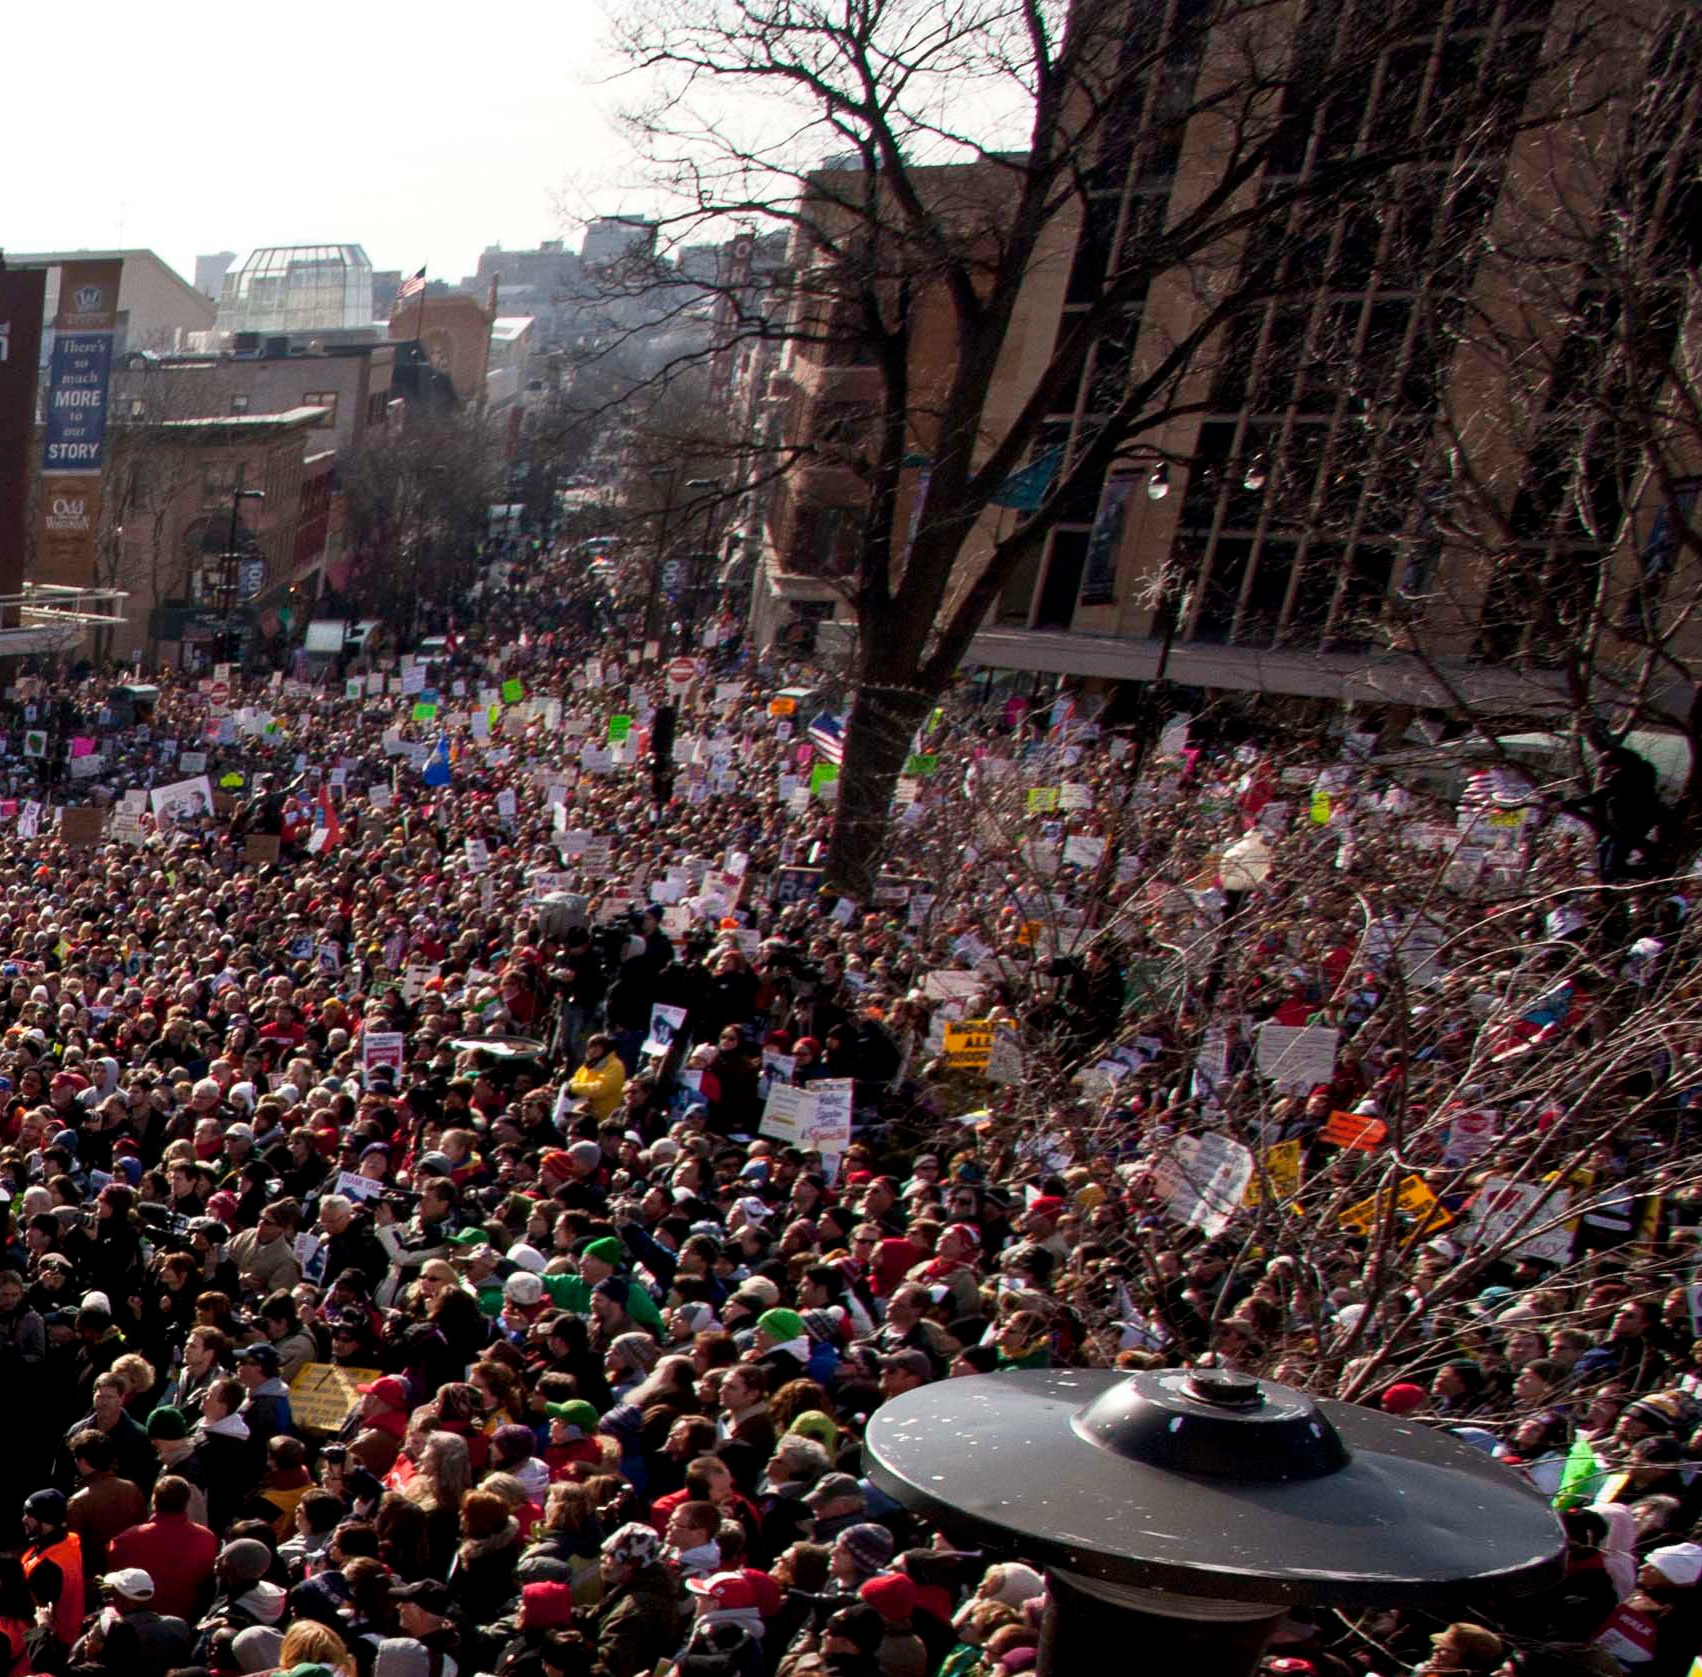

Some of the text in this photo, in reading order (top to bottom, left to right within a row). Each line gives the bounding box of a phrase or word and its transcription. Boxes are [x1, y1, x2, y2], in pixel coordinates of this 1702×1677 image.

[61, 339, 106, 355] There's
[61, 372, 98, 385] much
[54, 391, 102, 409] MORE
[70, 411, 84, 421] to
[48, 443, 101, 460] STORY
[52, 498, 86, 515] Odd
